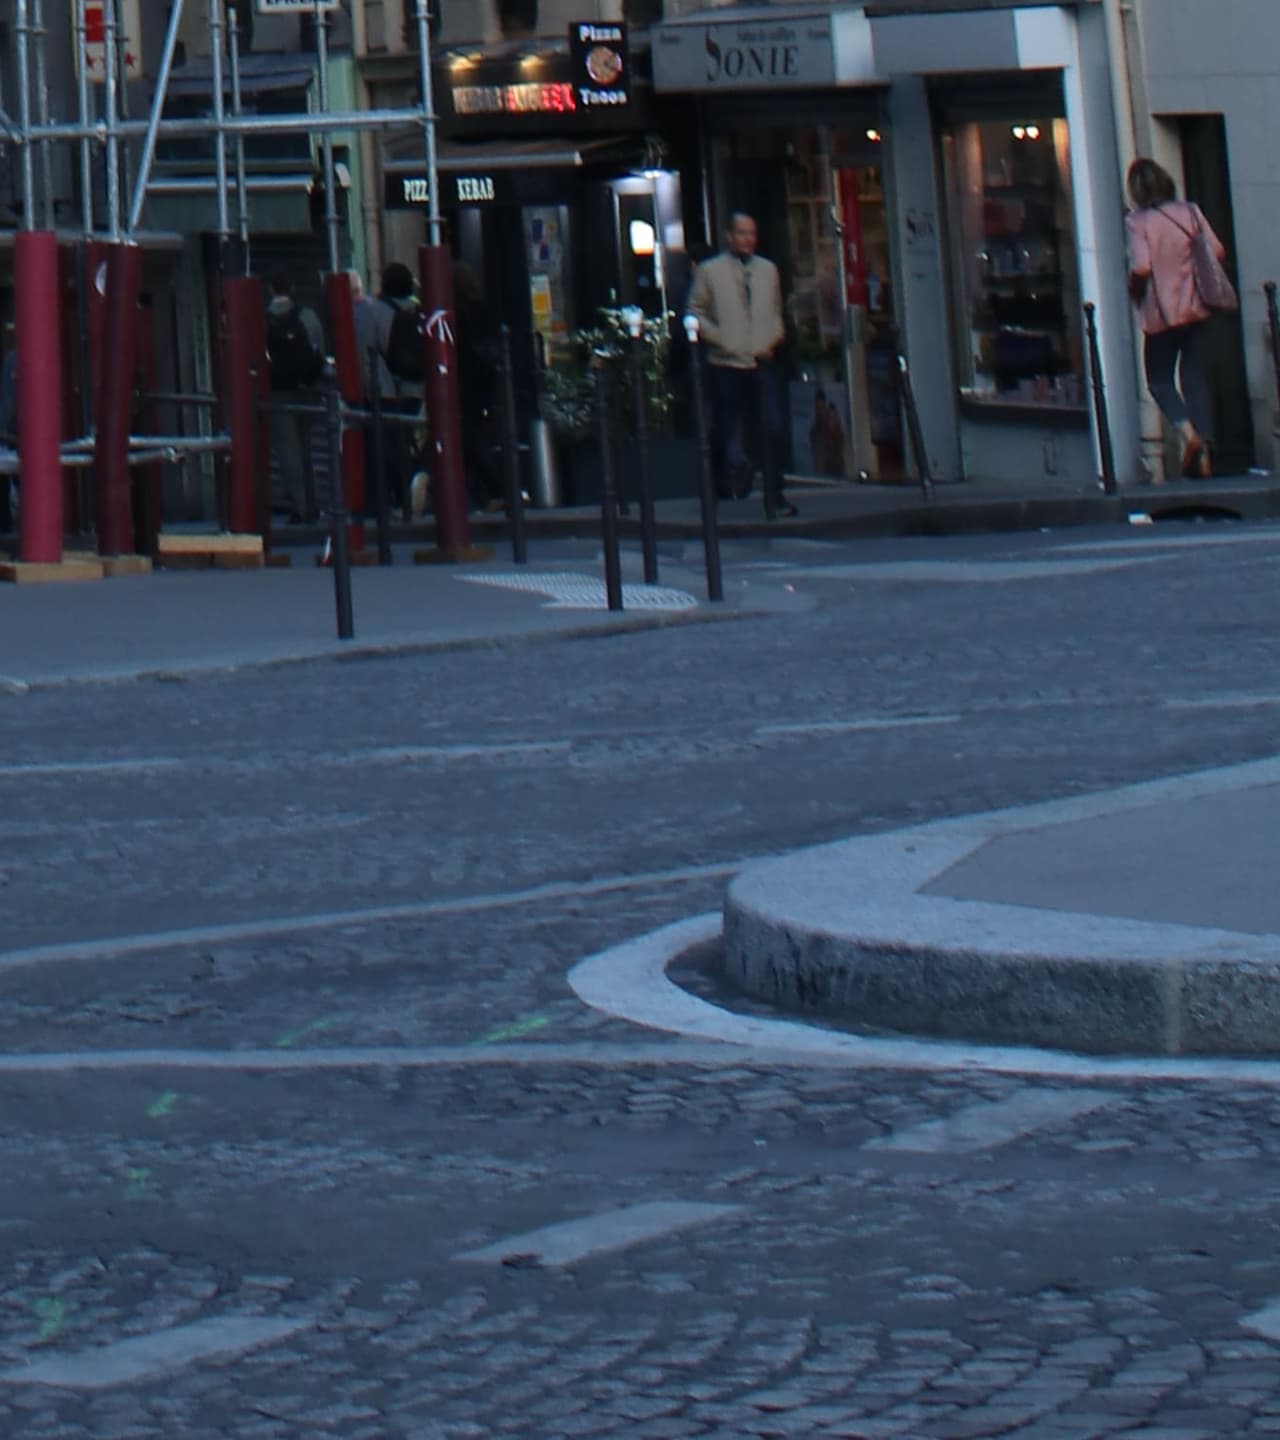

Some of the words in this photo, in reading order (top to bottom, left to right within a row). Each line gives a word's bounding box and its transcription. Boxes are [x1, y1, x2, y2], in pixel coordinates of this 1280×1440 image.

[578, 24, 622, 43] Pizza
[704, 25, 800, 84] SONIE
[402, 178, 438, 202] PIZZ
[456, 176, 495, 202] KEBAB
